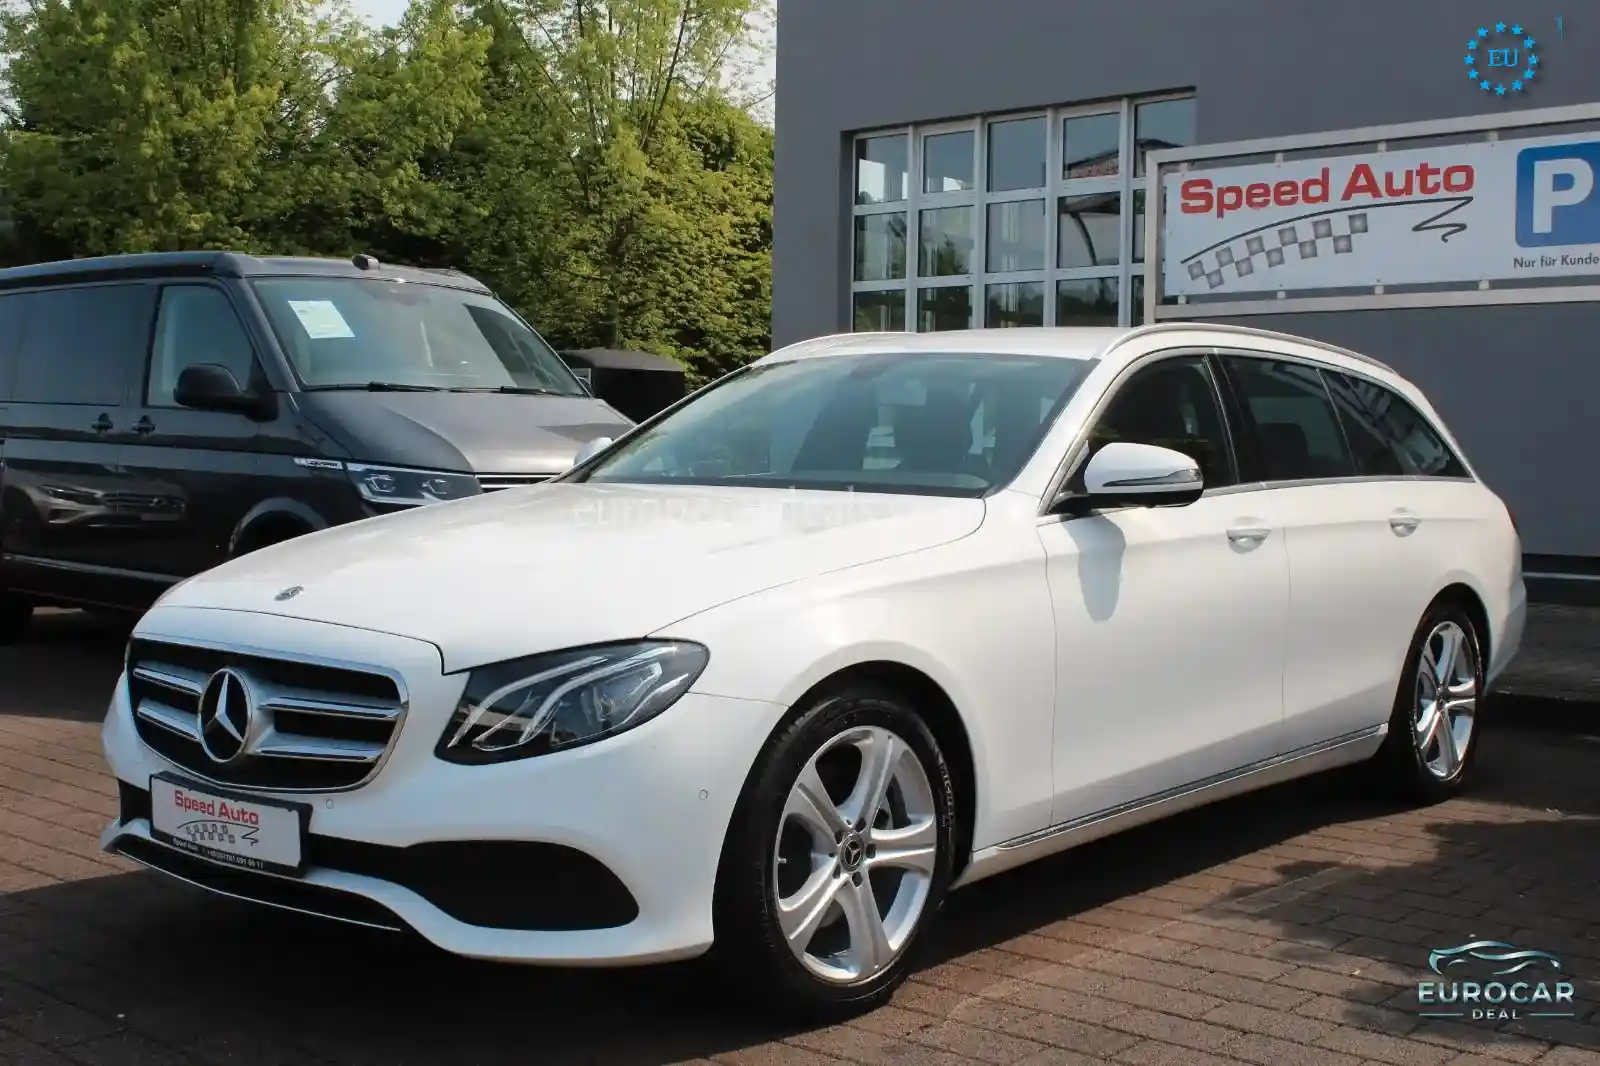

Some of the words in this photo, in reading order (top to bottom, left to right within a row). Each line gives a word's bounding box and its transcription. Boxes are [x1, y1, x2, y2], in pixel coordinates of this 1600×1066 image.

[1181, 167, 1330, 219] Speed
[1341, 162, 1475, 201] Auto
[1533, 158, 1594, 233] P
[1513, 257, 1536, 268] Nur
[1540, 255, 1557, 267] für
[174, 789, 215, 816] Speed
[218, 801, 259, 825] Auto
